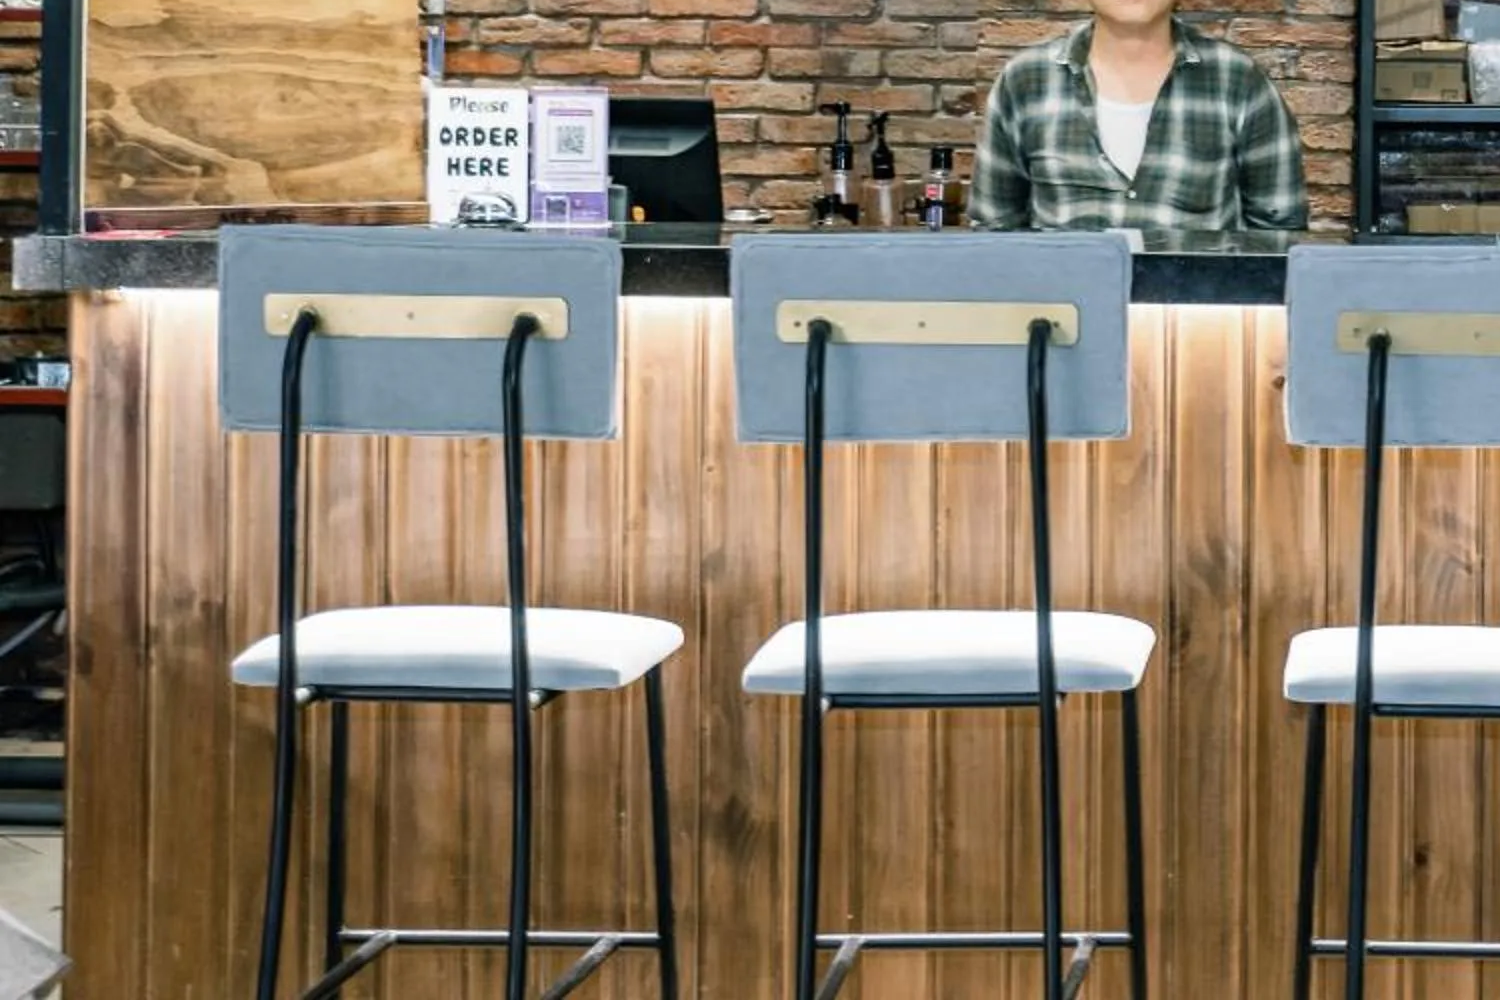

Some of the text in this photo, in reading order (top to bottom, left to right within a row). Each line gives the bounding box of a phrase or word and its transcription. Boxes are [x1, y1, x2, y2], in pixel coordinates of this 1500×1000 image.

[450, 95, 509, 113] Please
[439, 127, 519, 147] ORDER
[447, 157, 511, 177] HERE
